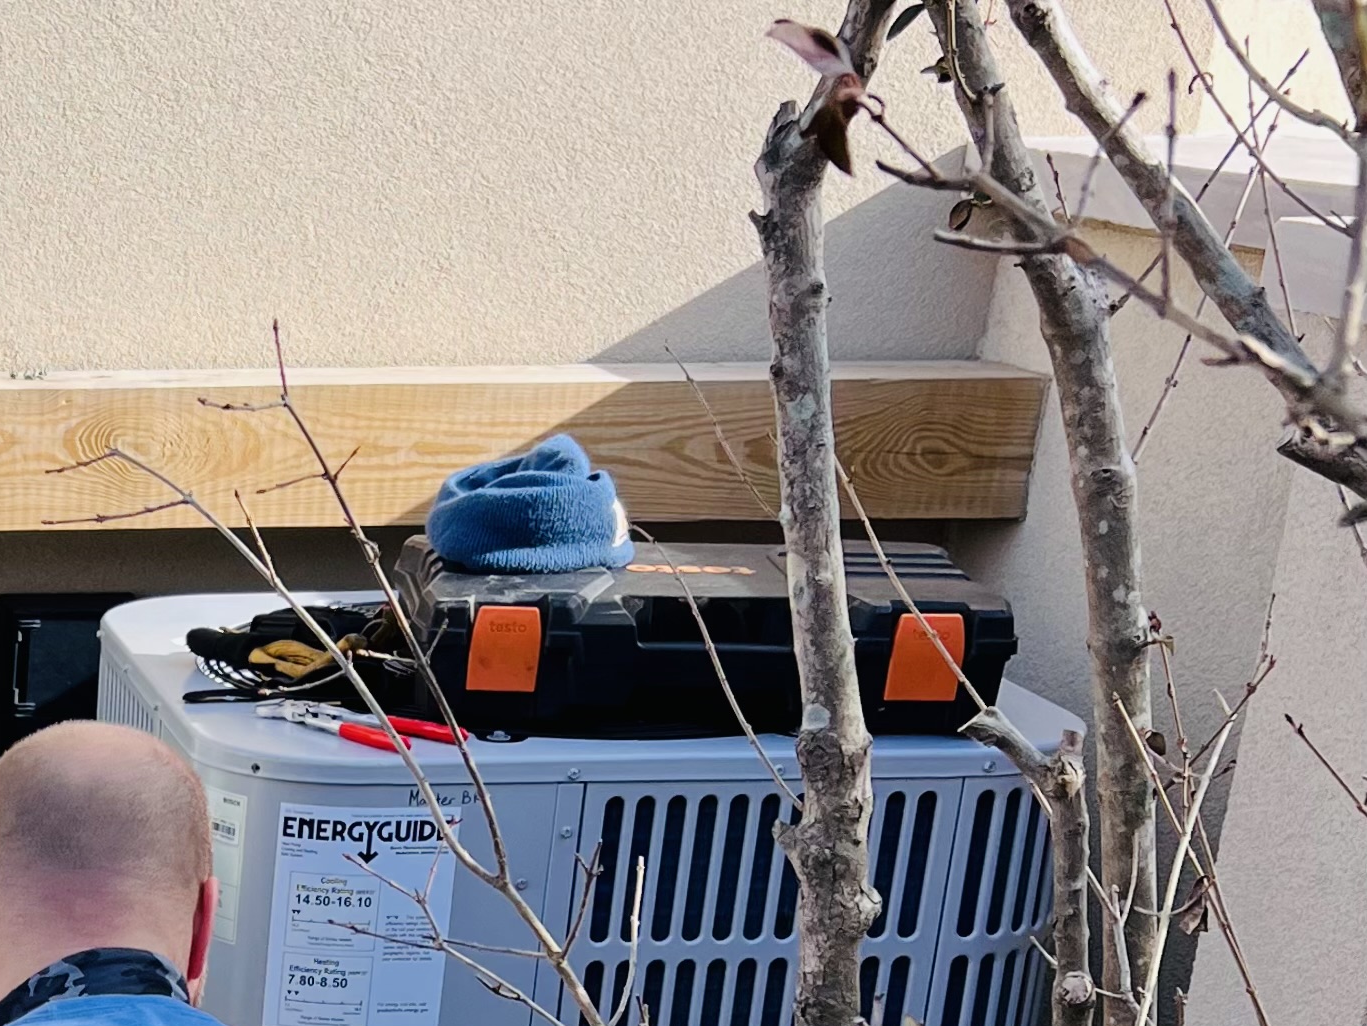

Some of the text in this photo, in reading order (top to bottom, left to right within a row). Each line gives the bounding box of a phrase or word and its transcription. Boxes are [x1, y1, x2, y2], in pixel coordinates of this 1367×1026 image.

[489, 620, 527, 633] testo
[913, 629, 951, 641] teo
[408, 789, 455, 806] Mater
[320, 877, 347, 886] Cooling
[296, 884, 330, 894] Efficiency
[331, 887, 354, 896] Rating
[296, 894, 372, 907] 14.50-16.10
[313, 958, 340, 967] Heating
[289, 965, 322, 975] Efficiency
[323, 968, 346, 977] Rating
[288, 974, 348, 989] 7.80-8.50
